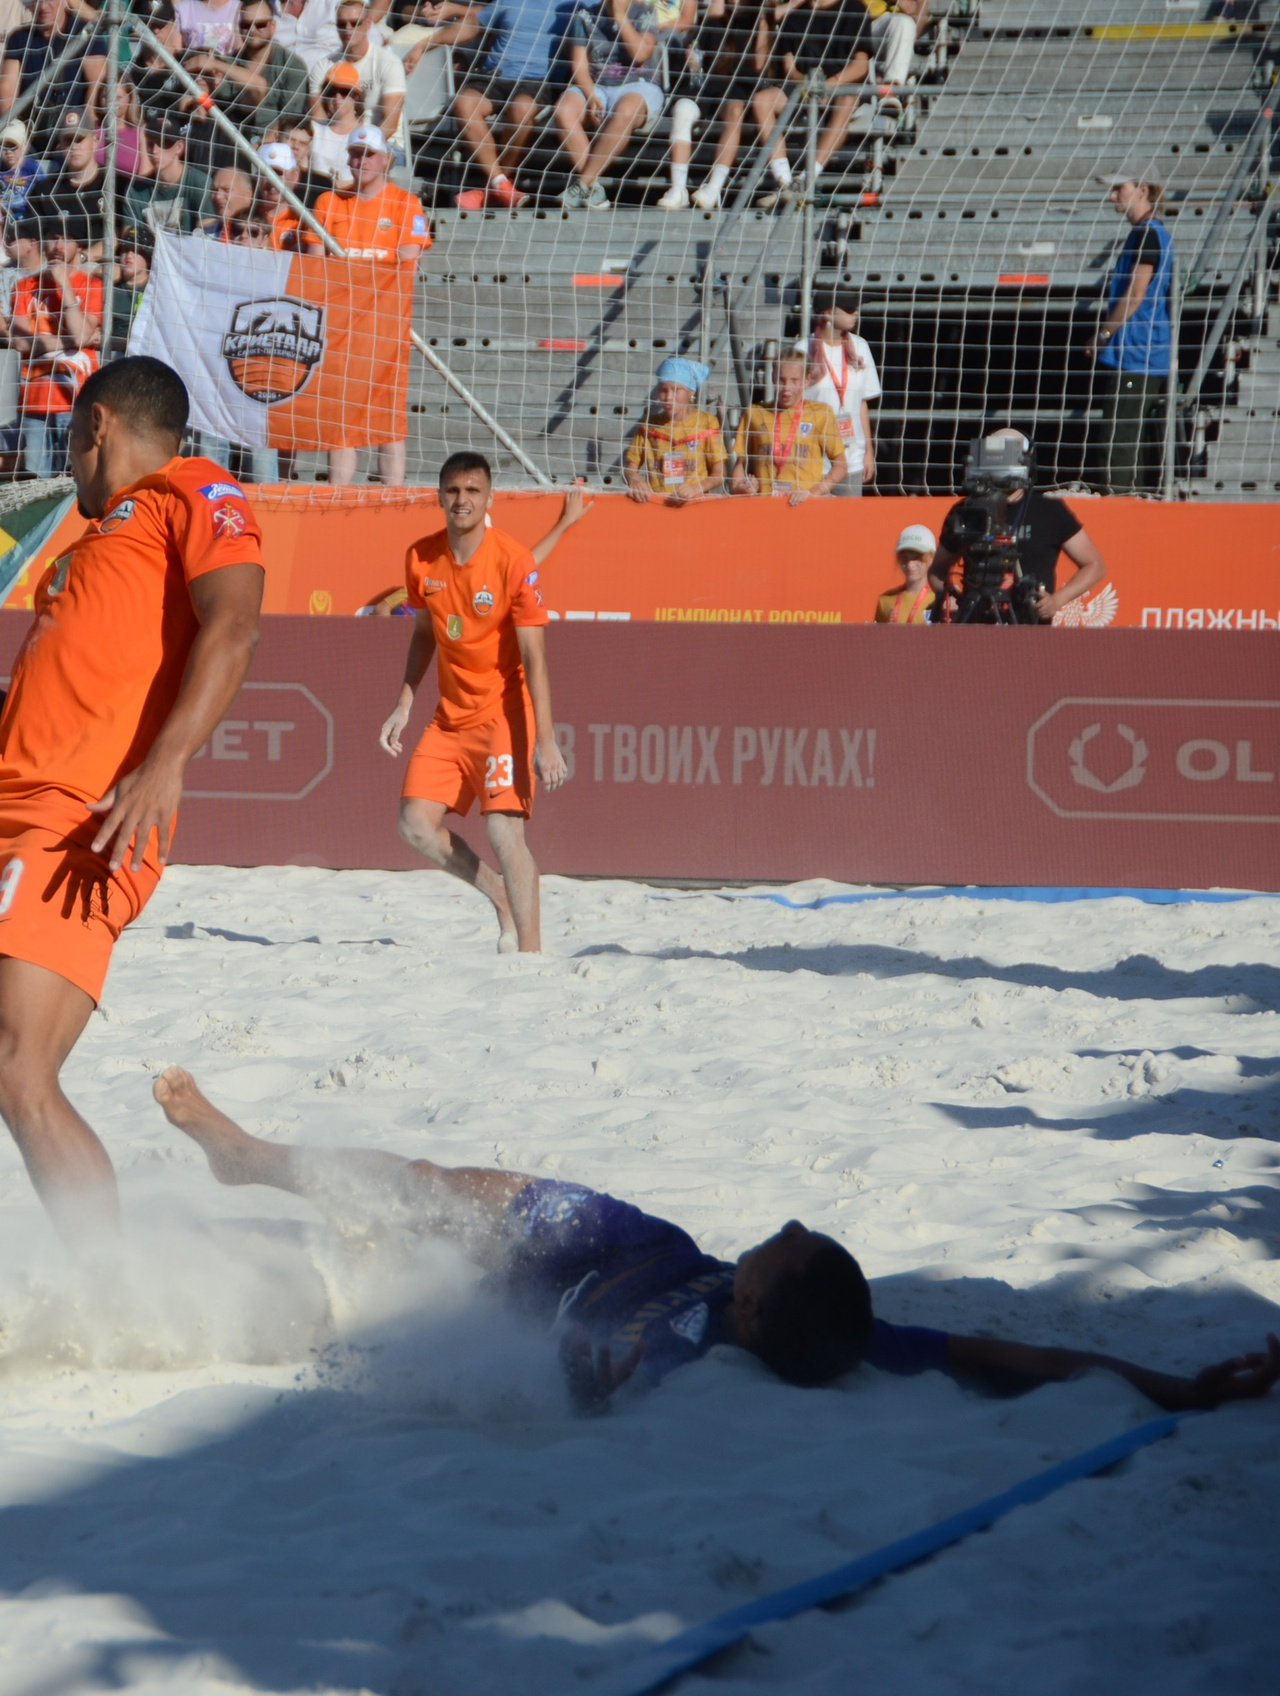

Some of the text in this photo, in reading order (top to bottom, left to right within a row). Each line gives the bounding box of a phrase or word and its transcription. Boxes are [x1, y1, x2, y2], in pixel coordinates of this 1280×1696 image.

[224, 331, 322, 357] КРИСТАЛЛ
[484, 753, 514, 788] 23
[587, 722, 721, 786] ТВОИХ
[732, 726, 878, 788] РУКАХ!
